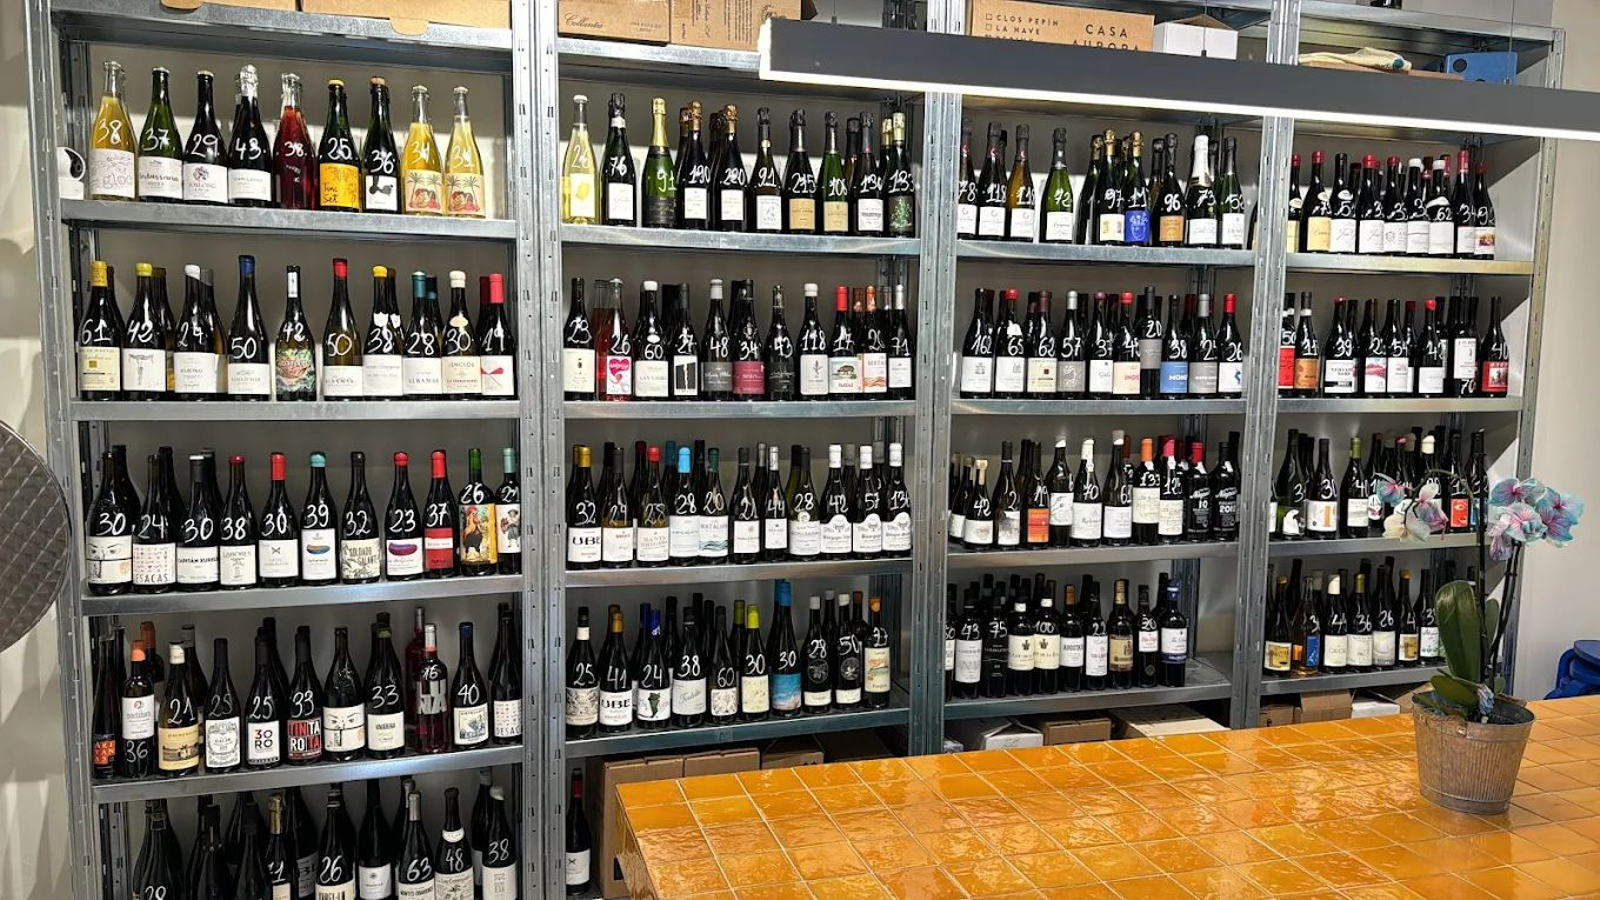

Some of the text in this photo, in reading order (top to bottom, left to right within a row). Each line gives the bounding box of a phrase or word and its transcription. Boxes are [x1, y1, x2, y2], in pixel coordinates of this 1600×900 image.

[997, 14, 1022, 23] CLOS
[1014, 26, 1040, 35] NAVE
[1085, 24, 1128, 38] CASA
[93, 120, 122, 145] 38
[142, 129, 171, 151] 37
[191, 133, 220, 159] 29
[235, 137, 261, 160] 43
[284, 141, 304, 157] 38
[327, 137, 350, 160] 25
[370, 150, 394, 174] 36
[609, 156, 627, 176] 76
[656, 168, 676, 192] 91
[725, 167, 744, 185] 220
[758, 167, 776, 188] 91
[791, 173, 815, 193] 215
[1055, 190, 1072, 208] 72
[1104, 188, 1123, 209] 97
[1164, 193, 1181, 212] 96
[82, 318, 111, 345] 61
[128, 320, 153, 343] 42
[283, 322, 303, 343] 42
[802, 329, 826, 351] 118
[1146, 320, 1163, 338] 20
[232, 338, 256, 359] 50
[327, 333, 352, 357] 50
[368, 328, 393, 353] 38
[408, 333, 434, 355] 28
[447, 330, 471, 355] 30
[611, 334, 631, 355] 26
[711, 336, 728, 358] 48
[740, 341, 760, 361] 34
[774, 336, 793, 358] 43
[891, 337, 908, 357] 71
[972, 334, 992, 355] 162
[1008, 336, 1024, 356] 65
[1060, 336, 1081, 358] 57
[1169, 340, 1188, 359] 38
[645, 344, 663, 360] 60
[1460, 379, 1476, 395] 70
[1139, 471, 1160, 487] 133
[460, 483, 485, 504] 26
[675, 493, 697, 515] 28
[703, 492, 724, 514] 20
[793, 493, 814, 513] 28
[865, 492, 881, 511] 57
[1083, 485, 1099, 501] 70
[303, 504, 330, 529] 39
[345, 510, 371, 537] 32
[389, 509, 416, 533] 23
[427, 502, 448, 528] 37
[575, 500, 597, 526] 32
[610, 504, 628, 526] 29
[98, 513, 126, 536] 30
[139, 514, 166, 540] 24
[183, 518, 213, 544] 30
[220, 516, 247, 541] 38
[261, 512, 287, 537] 30
[989, 621, 1008, 639] 75
[1033, 620, 1055, 634] 100
[1358, 614, 1373, 632] 36
[1379, 609, 1394, 632] 26
[961, 623, 982, 641] 43
[677, 655, 701, 677] 38
[745, 653, 766, 675] 30
[778, 650, 797, 670] 30
[573, 662, 596, 686] 25
[606, 666, 626, 689] 41
[641, 664, 663, 688] 24
[717, 667, 735, 688] 60
[291, 691, 315, 718] 33
[371, 685, 399, 708] 33
[457, 683, 480, 705] 40
[167, 697, 196, 725] 21
[210, 694, 234, 717] 25
[250, 696, 273, 720] 25
[289, 720, 320, 736] TIN TA
[127, 741, 148, 763] 36
[254, 740, 273, 749] RO
[290, 736, 320, 752] RO TA
[444, 848, 465, 872] 48
[487, 838, 510, 865] 38
[319, 854, 343, 885] 26
[406, 856, 433, 882] 63
